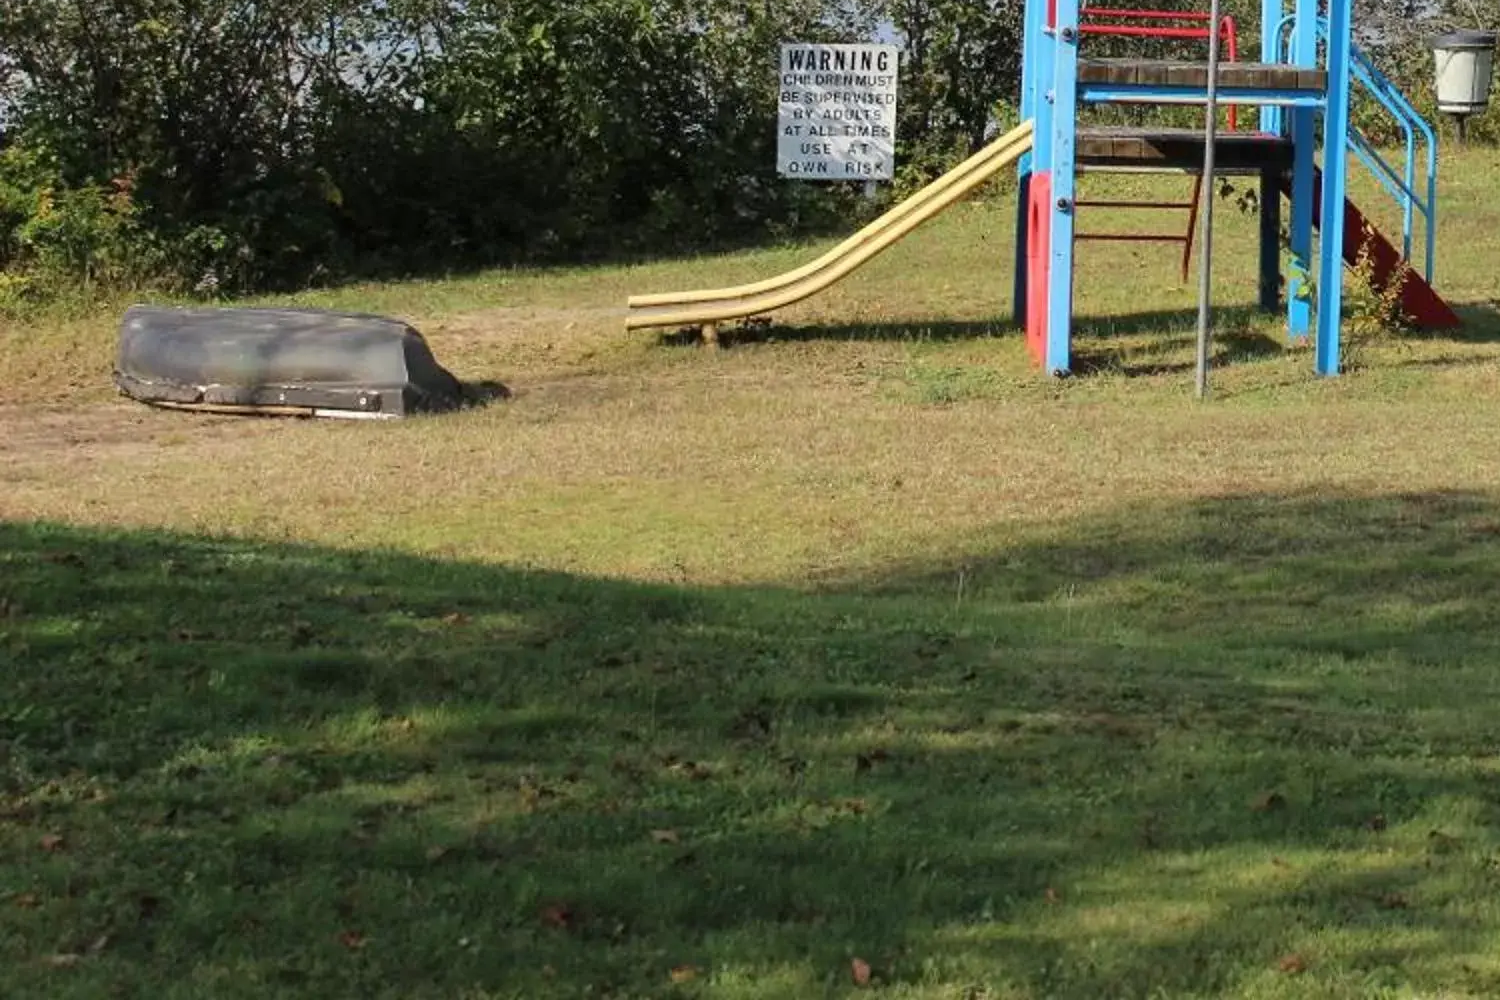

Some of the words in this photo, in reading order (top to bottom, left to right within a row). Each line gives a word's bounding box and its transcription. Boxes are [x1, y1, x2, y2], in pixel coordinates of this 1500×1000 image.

[789, 50, 888, 71] WARNING
[855, 75, 894, 87] MUST
[781, 91, 800, 103] BE
[804, 92, 895, 105] SUPERVISED
[793, 108, 813, 120] BY
[822, 109, 881, 121] ADULTS
[784, 125, 802, 136] AT
[809, 125, 837, 137] ALL
[842, 125, 891, 137] TIMES
[801, 143, 832, 155] USE
[847, 143, 869, 155] AT
[789, 161, 828, 173] OWN
[845, 161, 884, 175] RISK
